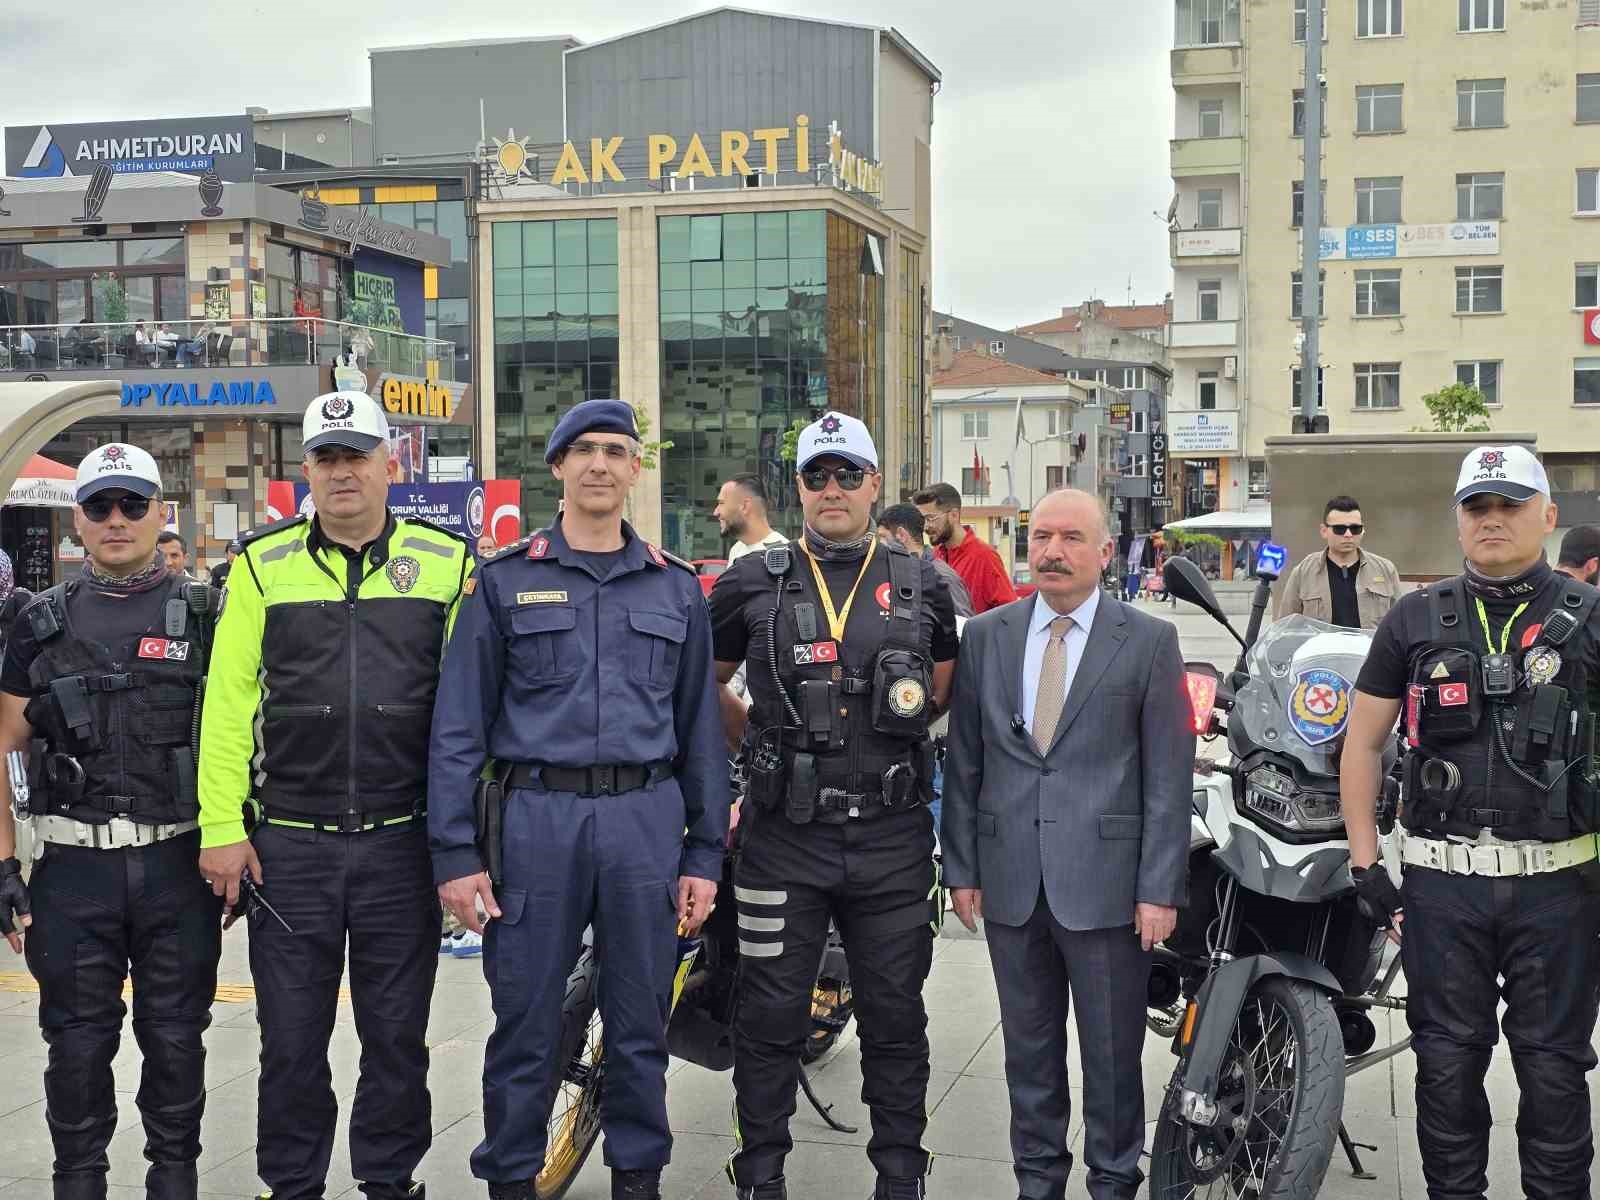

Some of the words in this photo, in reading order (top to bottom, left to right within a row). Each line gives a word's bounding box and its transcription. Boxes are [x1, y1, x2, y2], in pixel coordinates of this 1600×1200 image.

[551, 136, 625, 184] AK
[648, 114, 811, 180] PARTİ
[148, 160, 208, 171] KURUMLARI
[1365, 229, 1395, 242] SES
[120, 380, 276, 408] OPYALAMA
[383, 377, 453, 417] emin
[321, 419, 354, 430] POLİS
[98, 461, 133, 473] POLİS
[1152, 435, 1164, 495] ÖLÇÜ
[1473, 471, 1507, 481] POLİS
[388, 505, 417, 514] ORUM
[418, 503, 449, 514] VALİLİĞİ
